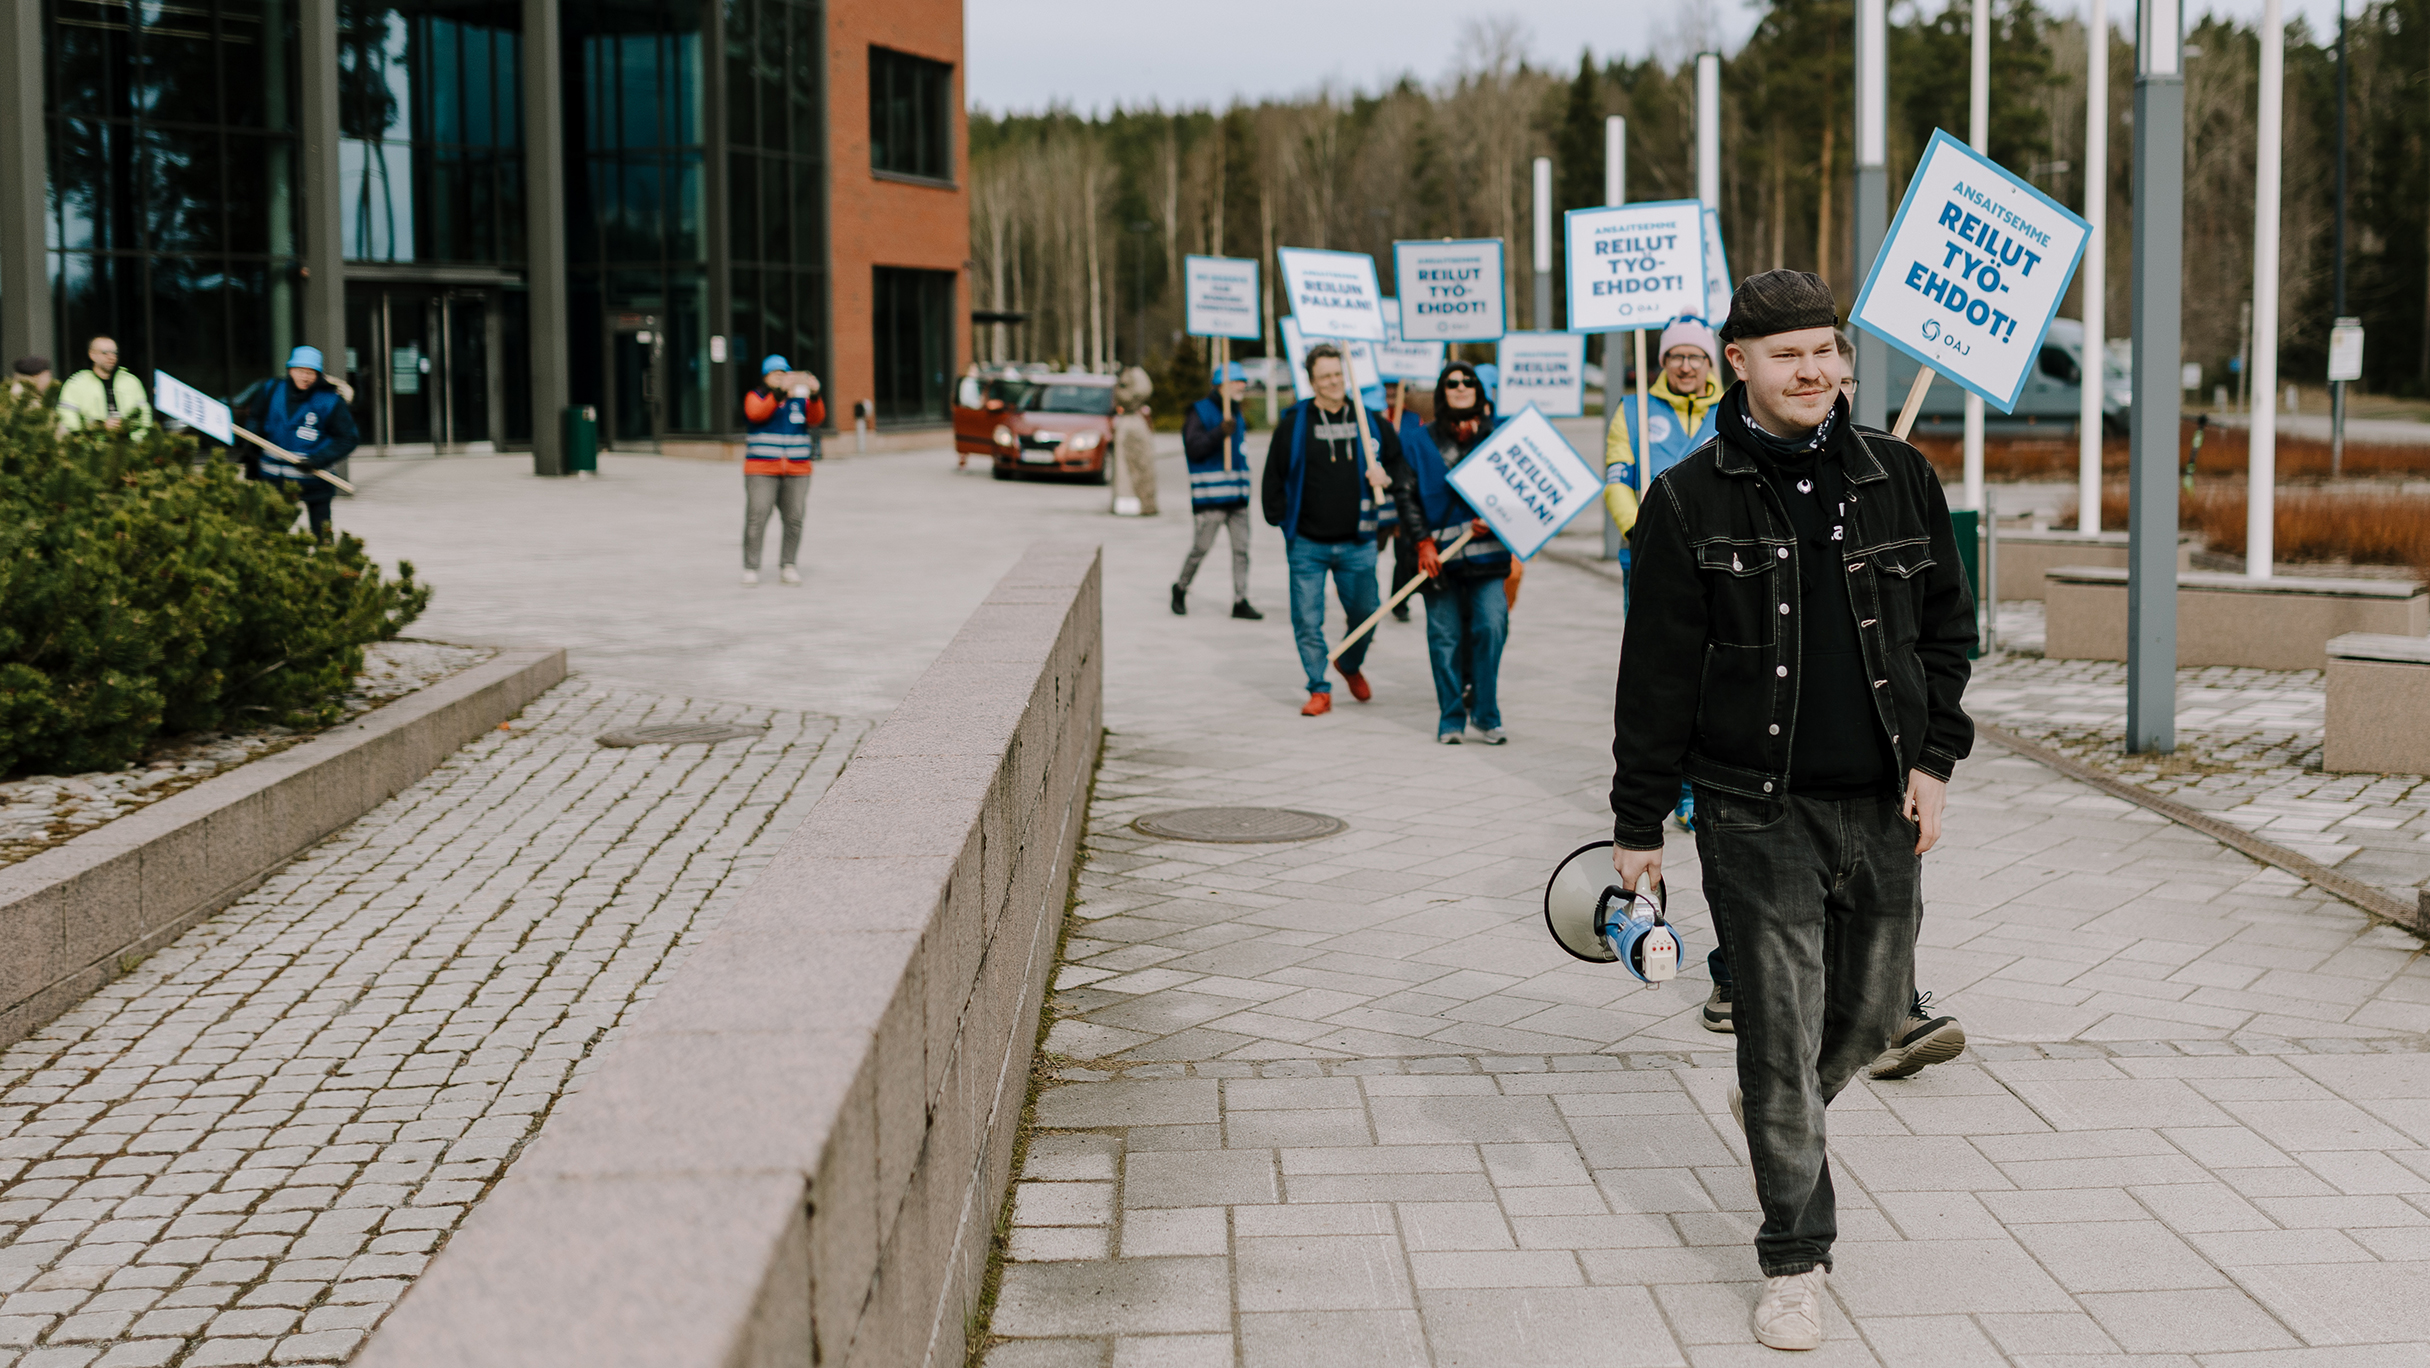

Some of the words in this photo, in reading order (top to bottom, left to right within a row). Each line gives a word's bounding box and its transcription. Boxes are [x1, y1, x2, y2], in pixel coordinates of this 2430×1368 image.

[1953, 180, 2051, 249] ANSAITSEMME
[1594, 221, 1677, 235] ANSAITSEMME
[1938, 200, 2042, 277] REILUT
[1594, 235, 1678, 256] REILUT
[1607, 251, 1666, 274] TYÖ-
[1942, 239, 2010, 295] TYÖ-
[1418, 268, 1482, 280] REILUT
[1303, 279, 1363, 295] REILUN
[1429, 281, 1473, 297] TYÖ-
[1592, 275, 1683, 297] EHDOT!
[1301, 294, 1373, 311] PALKAN!
[1417, 301, 1486, 314] EHDOT!
[1904, 261, 2018, 344] EHDOT!
[1943, 334, 1971, 356] OAJ
[1513, 362, 1568, 373] REILUN
[1507, 377, 1575, 387] PALKAN!
[1506, 443, 1563, 506] REILUN
[1487, 451, 1555, 526] PALKAN!
